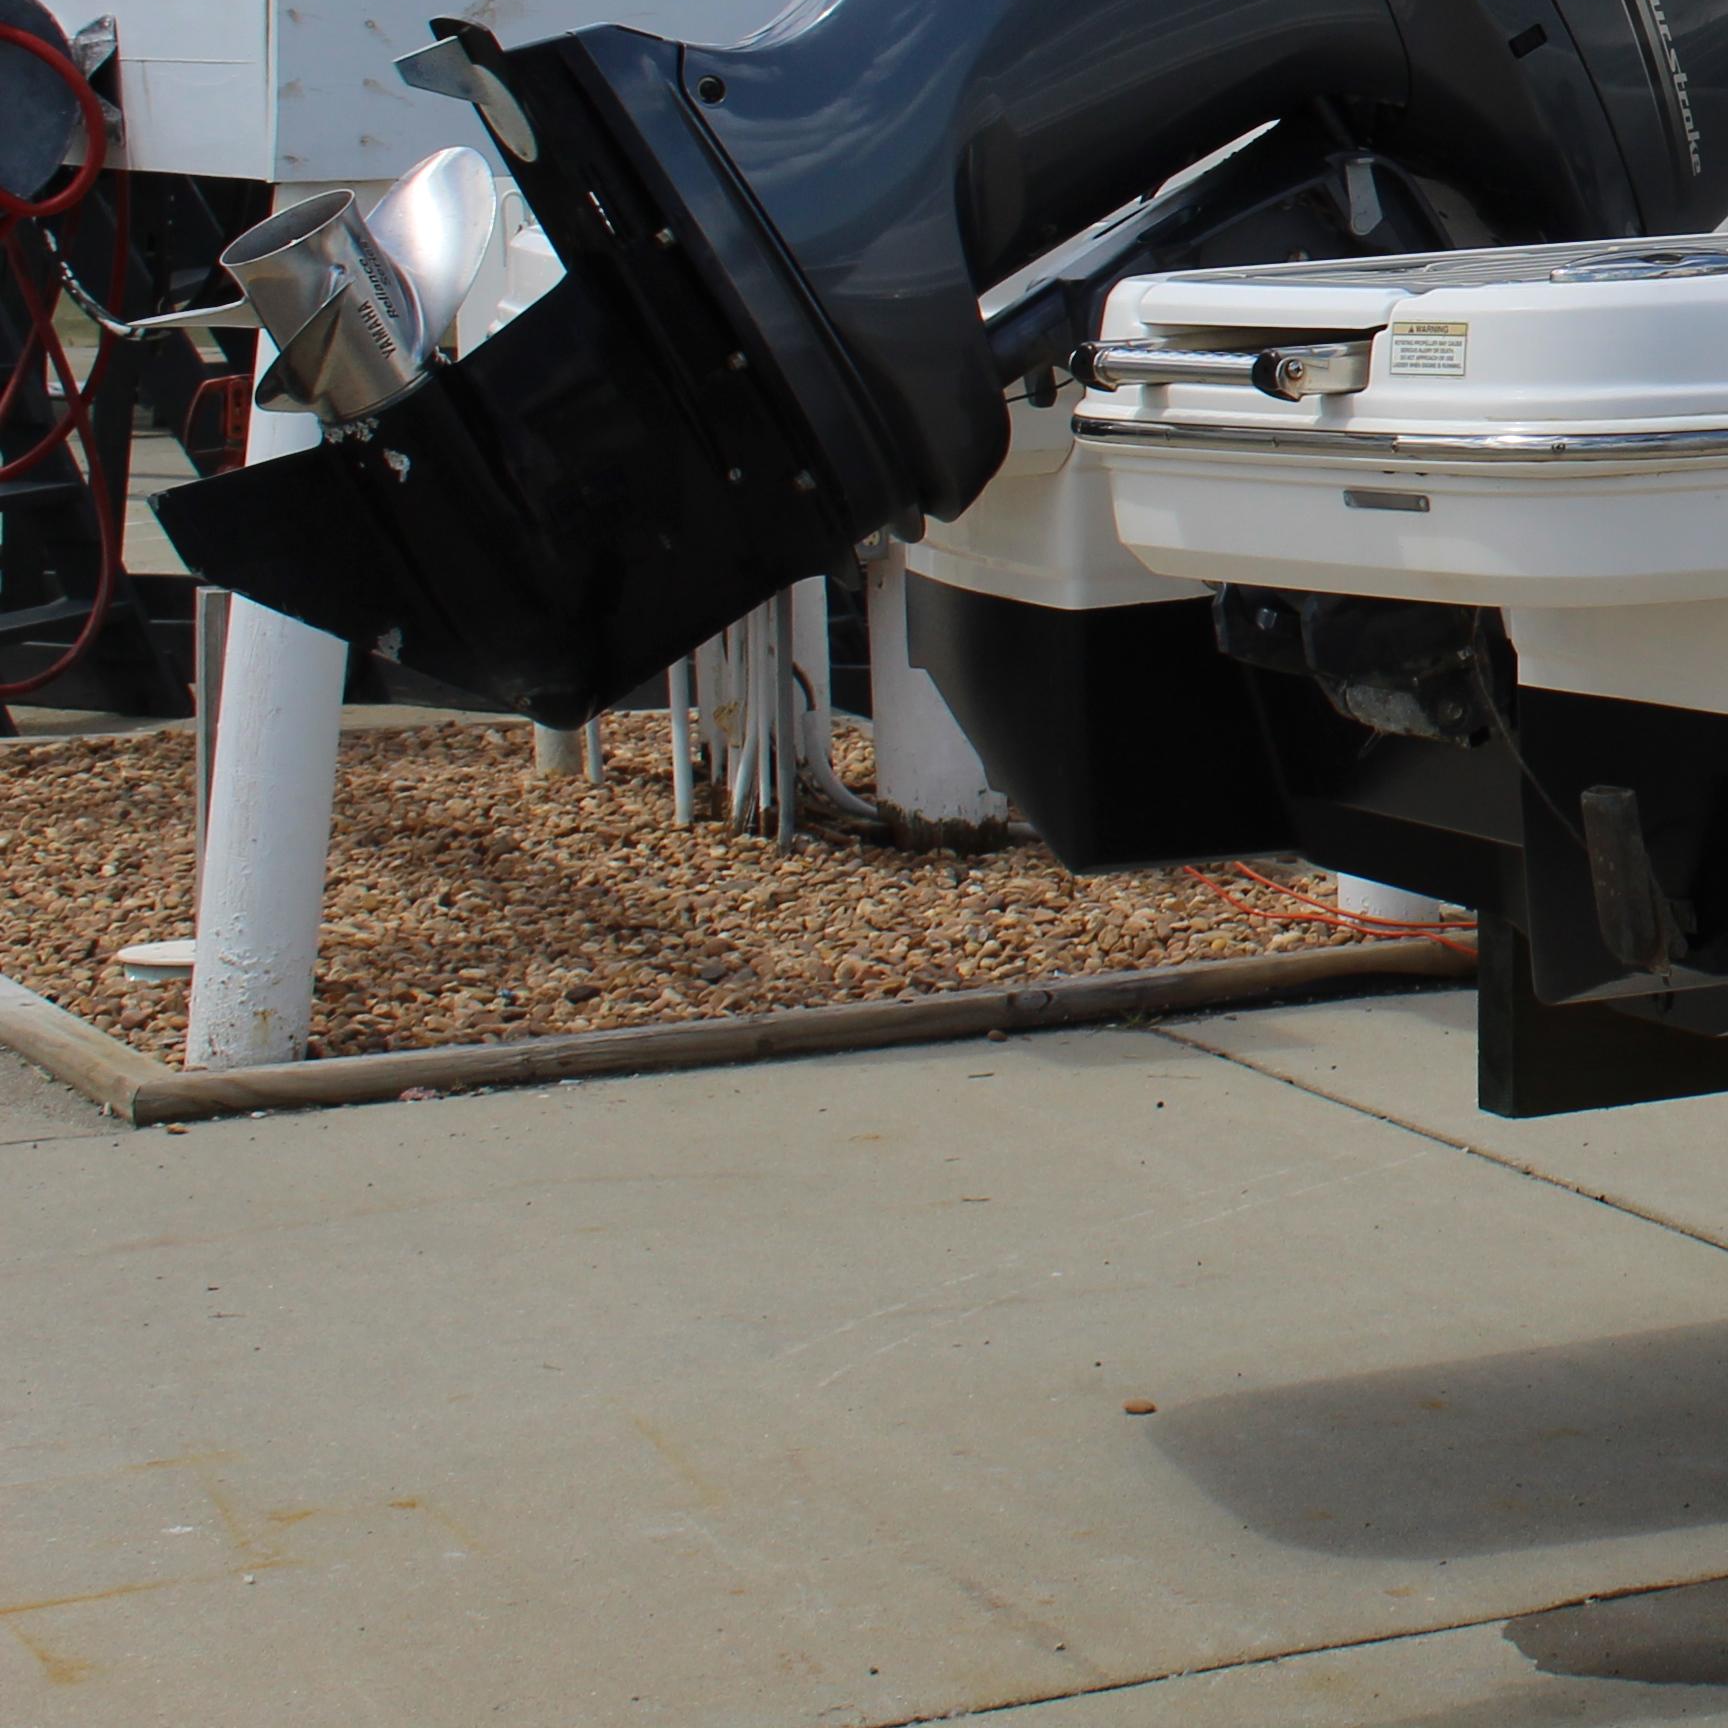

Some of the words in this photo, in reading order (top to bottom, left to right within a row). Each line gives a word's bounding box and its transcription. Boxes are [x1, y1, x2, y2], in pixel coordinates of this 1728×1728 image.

[359, 257, 399, 319] Reliance
[358, 300, 396, 360] YAMAHA
[1416, 325, 1449, 333] WARNING
